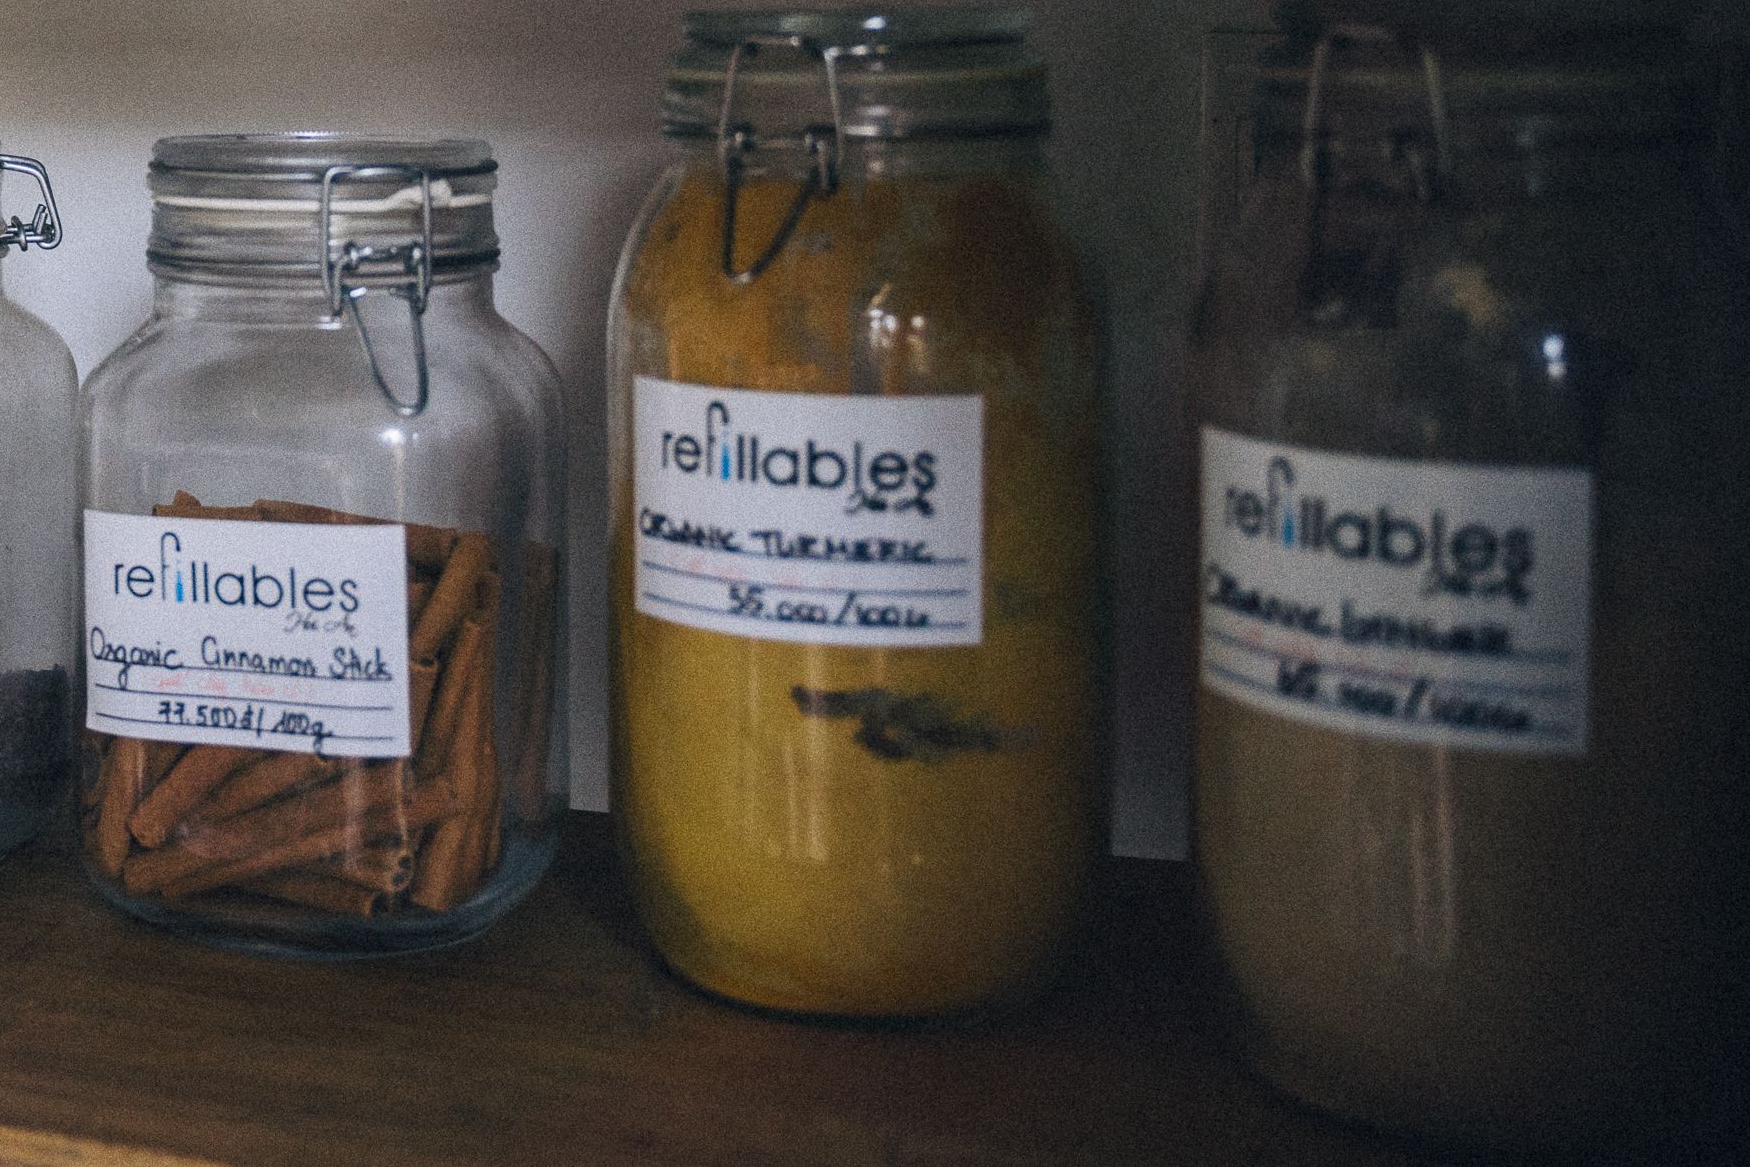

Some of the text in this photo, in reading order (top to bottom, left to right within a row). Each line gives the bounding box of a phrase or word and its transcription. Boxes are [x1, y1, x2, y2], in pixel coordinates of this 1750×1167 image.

[662, 400, 937, 491] refillables
[750, 530, 934, 564] TURMERIC
[1225, 455, 1534, 576] refillables
[115, 531, 359, 612] refillables
[90, 626, 183, 691] Organic
[201, 635, 316, 677] Cinnamon
